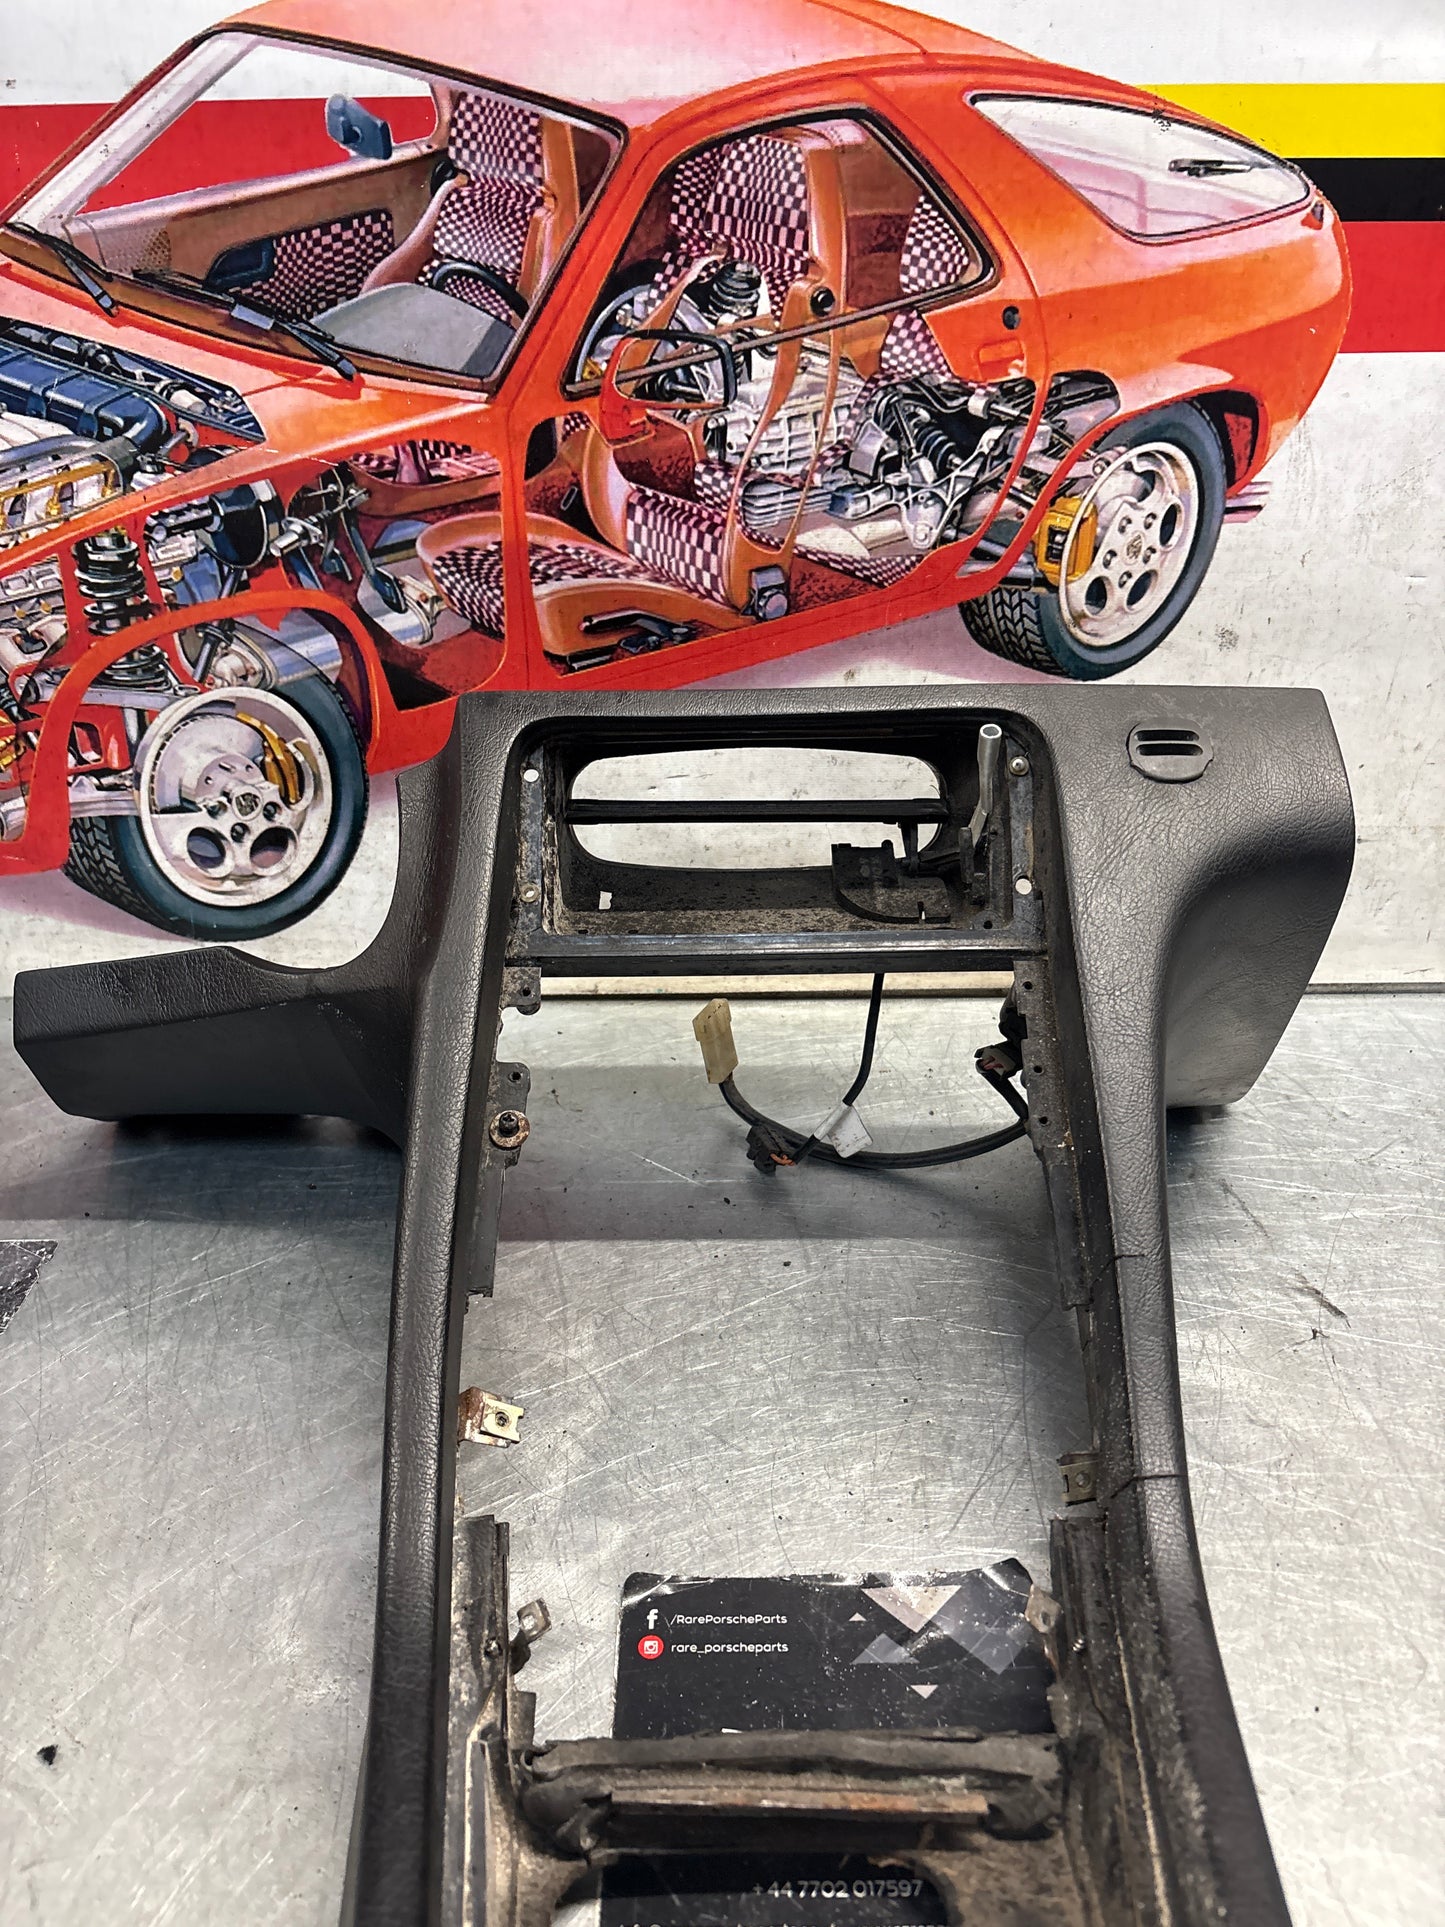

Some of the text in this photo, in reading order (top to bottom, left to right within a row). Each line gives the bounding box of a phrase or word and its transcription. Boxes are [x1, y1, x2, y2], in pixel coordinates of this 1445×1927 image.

[670, 1613, 788, 1626] /RarePorscheParts
[671, 1641, 789, 1656] rare_porscheparts
[798, 1880, 849, 1898] 7702
[852, 1879, 923, 1898] 017597
